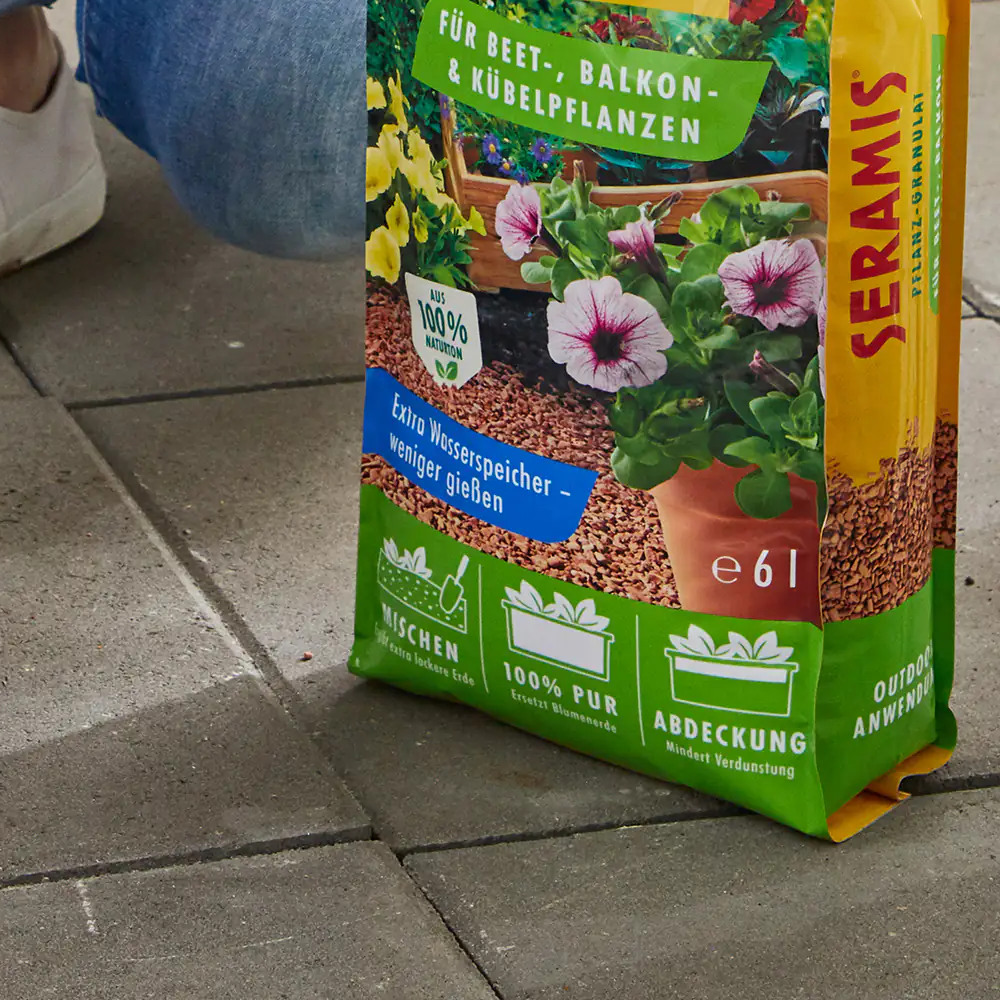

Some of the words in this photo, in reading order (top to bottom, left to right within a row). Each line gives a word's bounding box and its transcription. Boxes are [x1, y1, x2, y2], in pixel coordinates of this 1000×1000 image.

[439, 7, 476, 50] FÜR
[487, 30, 565, 83] BEET-,
[580, 58, 719, 103] BALKON-
[447, 57, 461, 85] &
[471, 66, 700, 144] KÜBELPFLANZEN
[912, 92, 924, 299] PFLANZ-GRANULAT
[417, 299, 468, 345] 100%
[430, 288, 446, 305] AUS
[425, 334, 463, 361] NATURTON
[391, 392, 425, 436] Extra
[429, 417, 552, 497] Wasserspeicher
[389, 432, 442, 481] weniger
[446, 471, 504, 514] gießen
[381, 602, 459, 663] MISCHEN
[414, 652, 449, 678] lockere
[452, 668, 476, 687] Erde
[503, 661, 562, 698] 100%
[572, 684, 618, 717] PUR
[511, 688, 549, 710] Ersetzt
[551, 702, 617, 734] Blumenerde
[653, 709, 807, 755] ABDECKUNG
[665, 739, 711, 764] Mindert
[714, 753, 796, 780] Verdunstung
